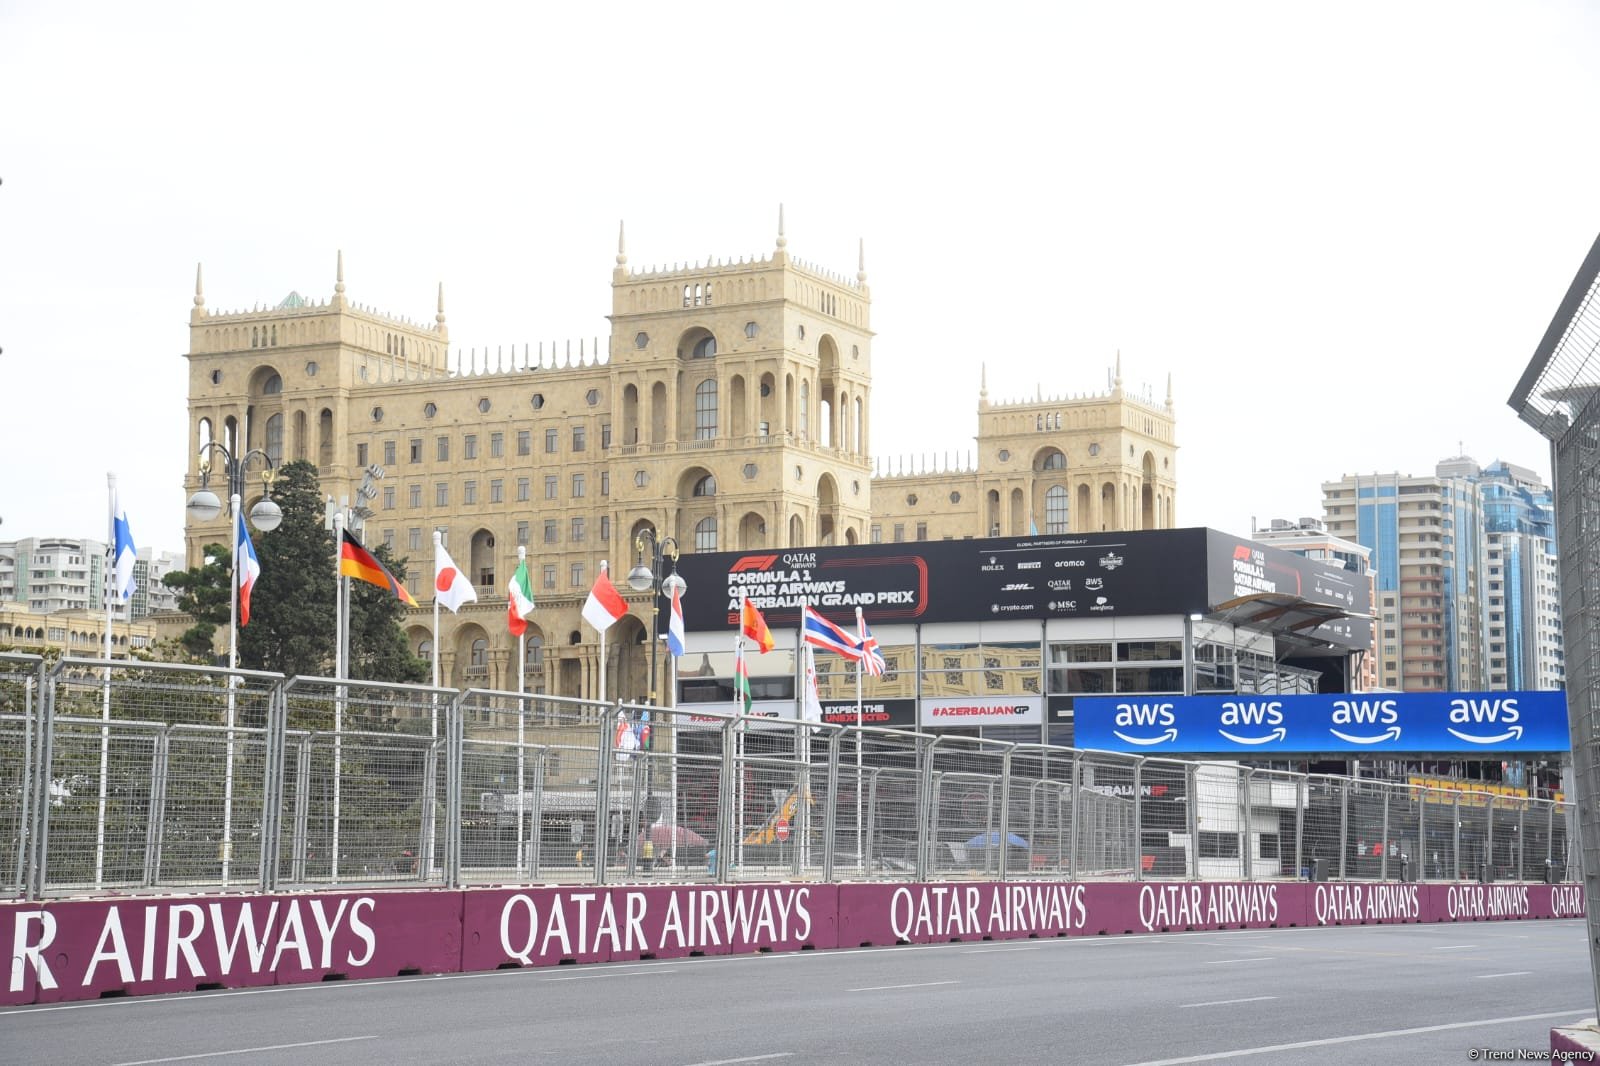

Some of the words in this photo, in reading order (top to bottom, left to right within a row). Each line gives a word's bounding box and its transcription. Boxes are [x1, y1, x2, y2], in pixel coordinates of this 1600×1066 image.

[783, 553, 816, 564] QATAR
[1055, 560, 1085, 568] aramco
[728, 571, 800, 585] FORMULA
[803, 570, 811, 581] 1
[779, 581, 845, 595] AIRWAYS
[1048, 580, 1071, 588] QATAR
[728, 595, 819, 610] AERBAIJN
[822, 592, 876, 607] GRAND
[877, 590, 915, 604] PRIX
[1001, 604, 1034, 612] crypto.com
[825, 705, 862, 714] EXPEC
[864, 705, 885, 713] THE
[825, 713, 890, 722] UNEXPCTED
[932, 706, 1030, 717] #AZERBAIJANGP
[1115, 703, 1175, 726] aws
[1221, 701, 1284, 726] aws
[1332, 700, 1398, 725] aws
[1449, 698, 1520, 724] aws
[891, 887, 984, 942] QATAR
[988, 883, 1086, 933] AIRWAYS
[1139, 885, 1202, 931] QATAR
[1207, 884, 1278, 924] AIRWAYS
[1315, 885, 1363, 925] QATAR
[1366, 884, 1419, 919] AIRWAYS
[1447, 886, 1485, 918] QATAR
[1487, 886, 1529, 916] AIRWAYS
[1551, 886, 1581, 917] QATAR
[500, 892, 648, 965] QATAR
[659, 887, 812, 952] AIRWAYS
[9, 910, 58, 992] R
[82, 897, 377, 987] AIRWAYS
